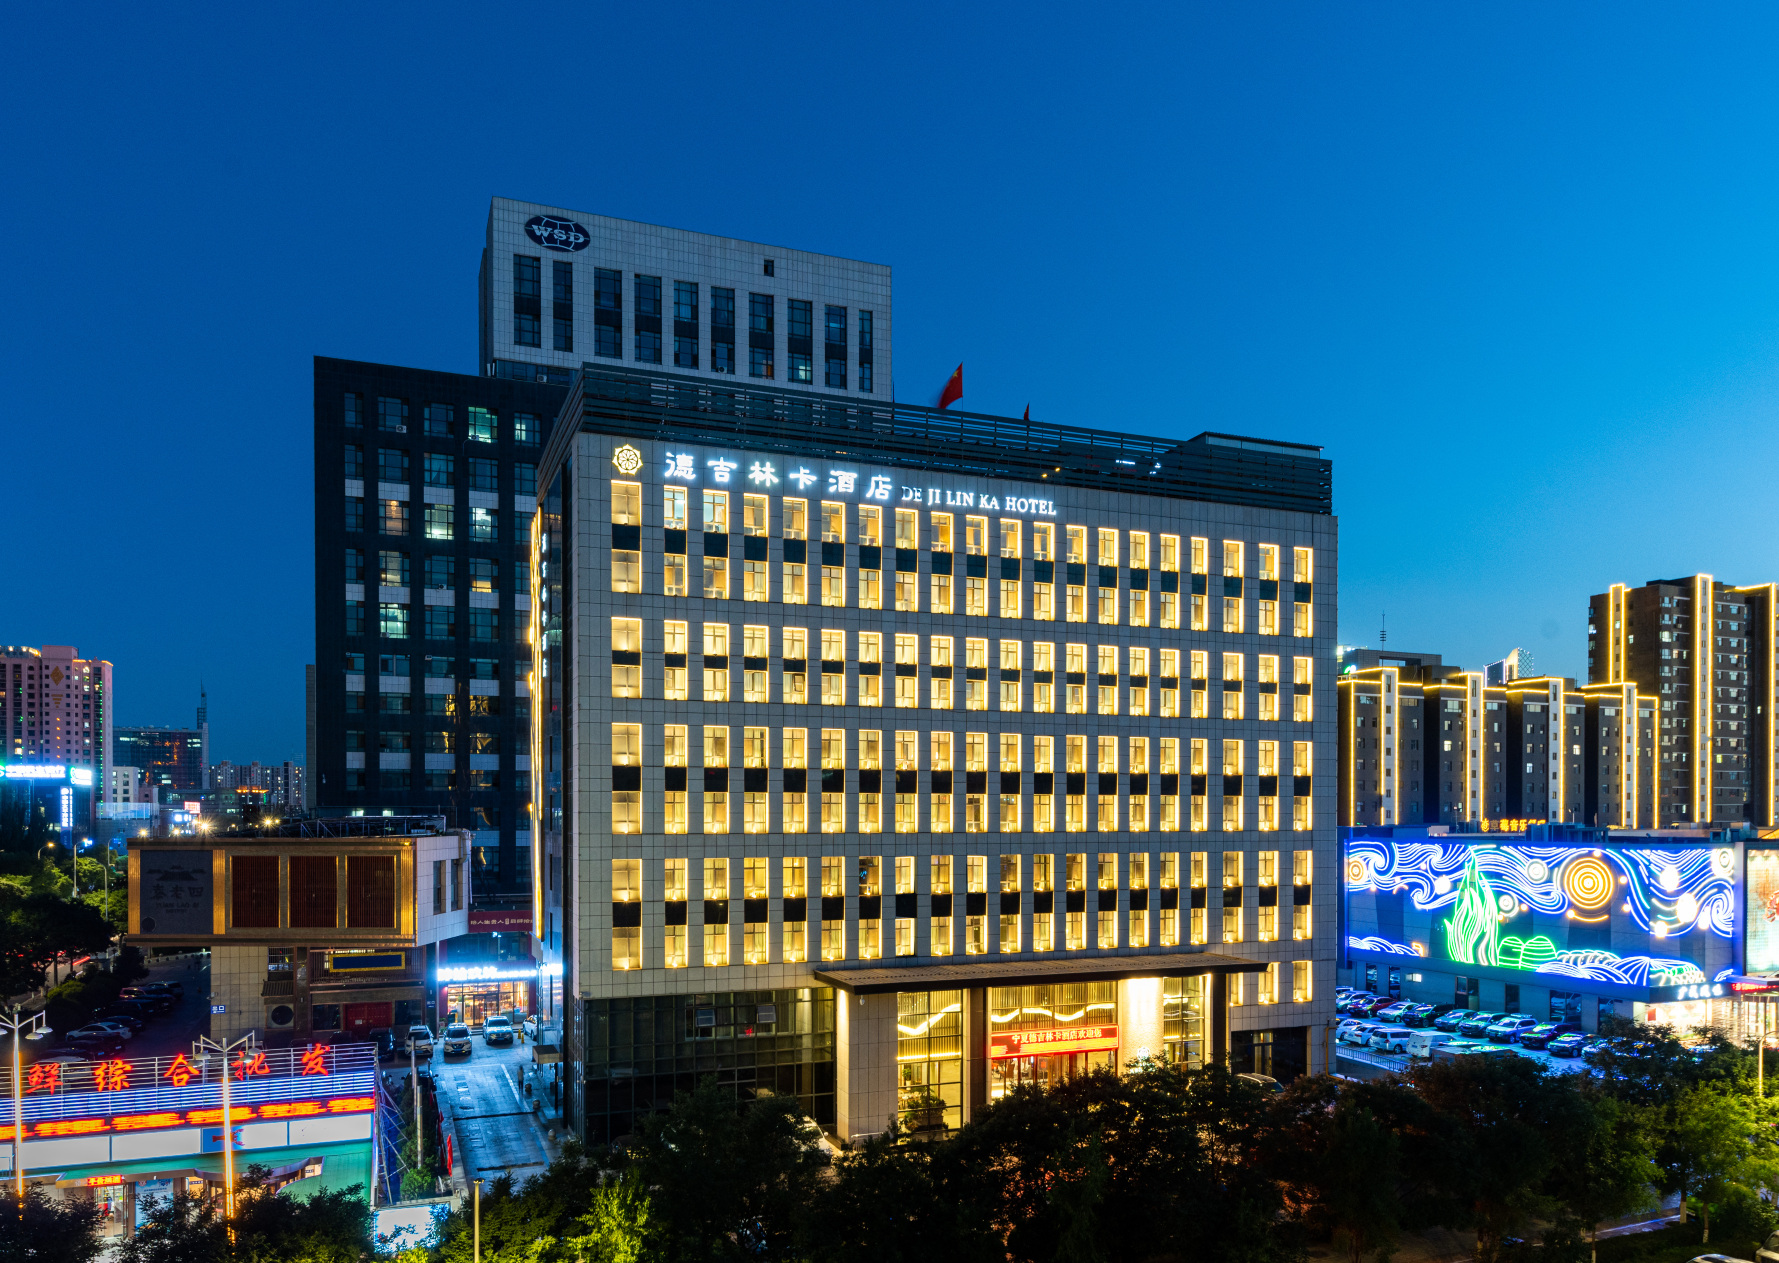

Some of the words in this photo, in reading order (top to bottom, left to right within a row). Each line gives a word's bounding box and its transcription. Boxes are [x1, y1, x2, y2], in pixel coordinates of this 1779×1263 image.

[531, 224, 585, 243] WSD
[664, 452, 893, 500] 德吉林卡酒店
[901, 486, 922, 502] DE
[927, 488, 941, 506] JI
[946, 490, 974, 507] LIN
[979, 493, 1000, 510] KA
[1005, 496, 1057, 516] HOTEL
[25, 1043, 331, 1095] 鲜综合批发
